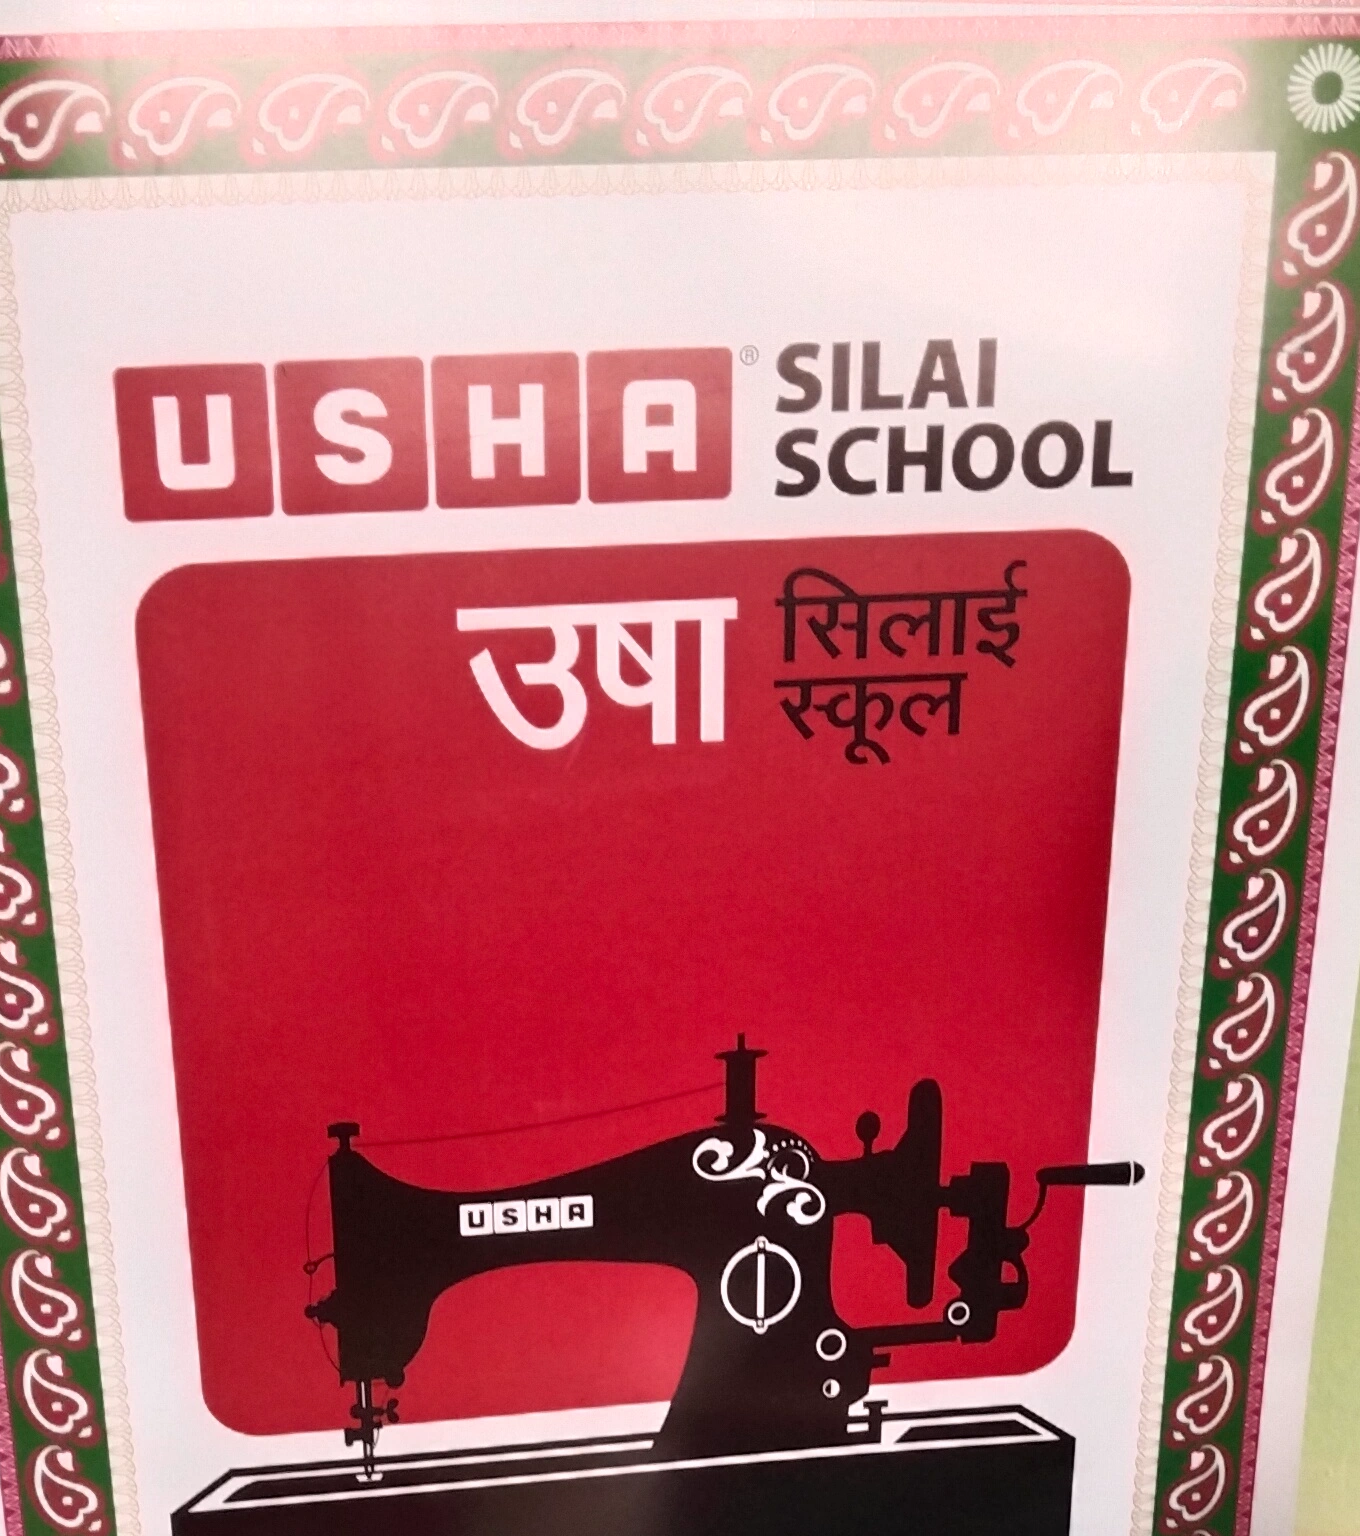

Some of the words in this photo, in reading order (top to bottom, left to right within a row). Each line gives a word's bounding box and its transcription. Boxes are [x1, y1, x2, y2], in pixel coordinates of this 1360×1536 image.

[773, 336, 1000, 414] SILAI
[151, 376, 698, 492] USHA
[773, 417, 1135, 499] SCHOOL
[773, 559, 1030, 669] सिलाई
[455, 596, 739, 752] उषा
[773, 670, 969, 766] स्कूल
[465, 1201, 588, 1231] USHA
